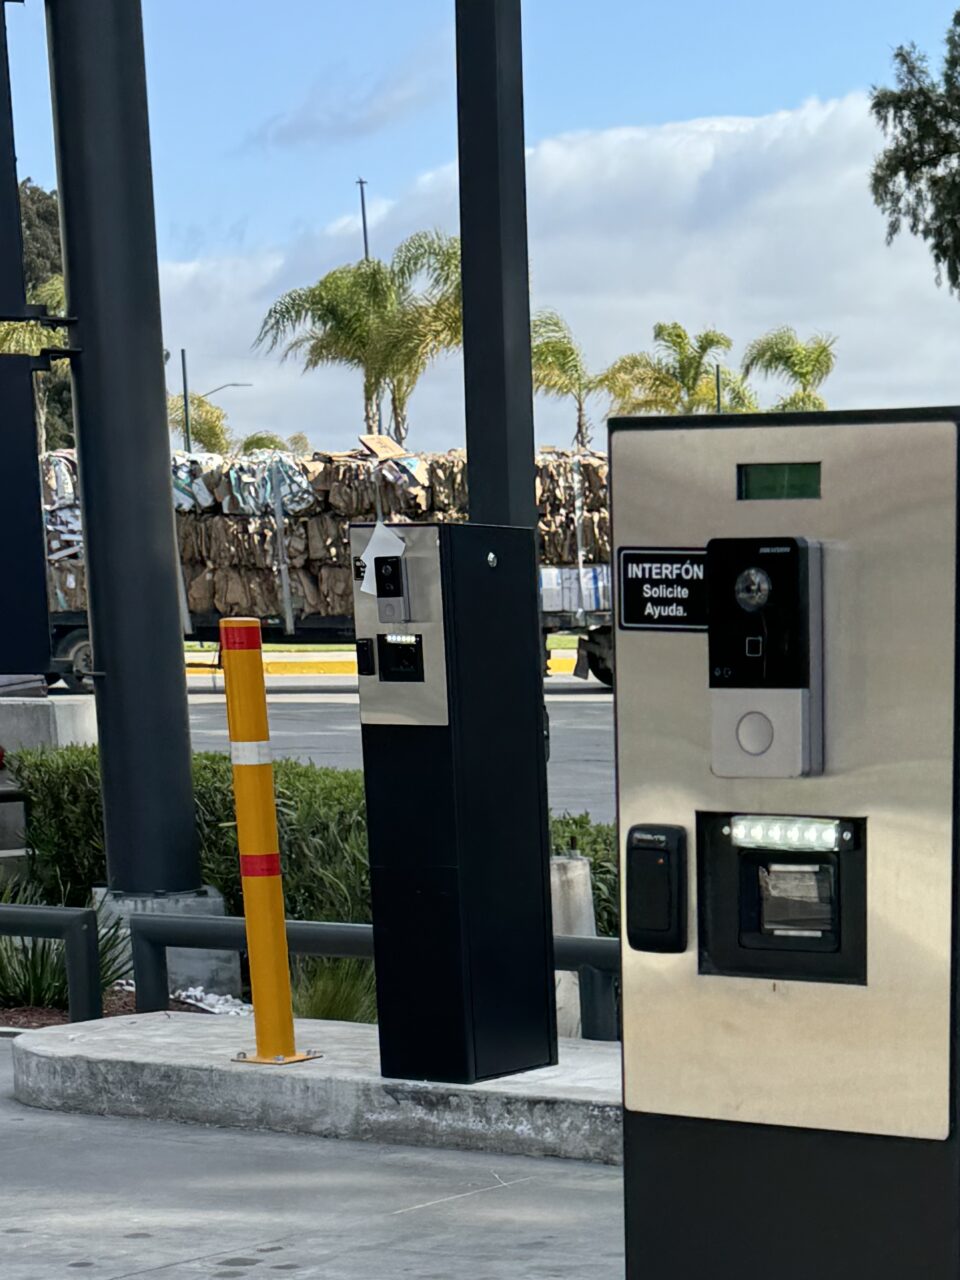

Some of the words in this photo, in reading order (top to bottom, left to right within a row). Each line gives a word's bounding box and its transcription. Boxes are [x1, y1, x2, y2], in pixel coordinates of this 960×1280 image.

[627, 559, 704, 580] INTERFÓN
[642, 583, 689, 599] Solicite
[643, 601, 688, 619] Ayuda.
